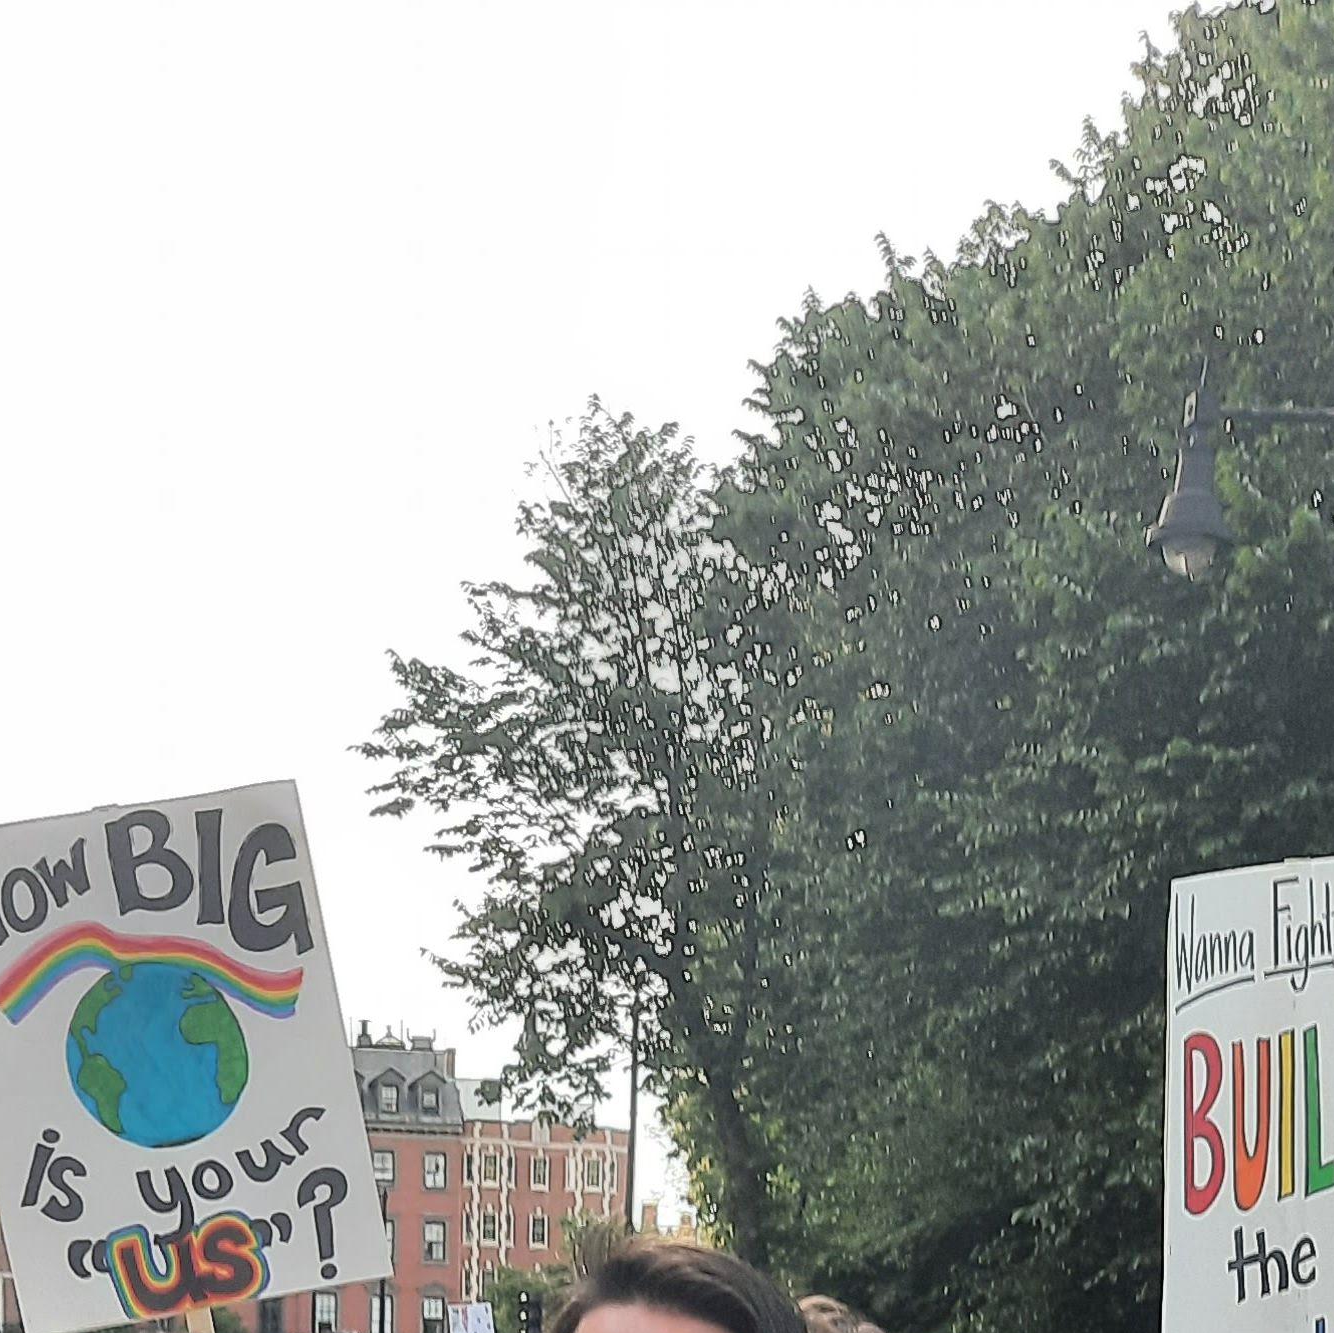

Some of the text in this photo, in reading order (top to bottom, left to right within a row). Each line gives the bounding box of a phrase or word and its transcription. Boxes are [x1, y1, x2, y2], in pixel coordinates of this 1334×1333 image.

[104, 809, 315, 955] BIG
[1175, 892, 1255, 992] Wanna
[21, 1107, 326, 1250] is your
[1228, 1227, 1317, 1303] the
